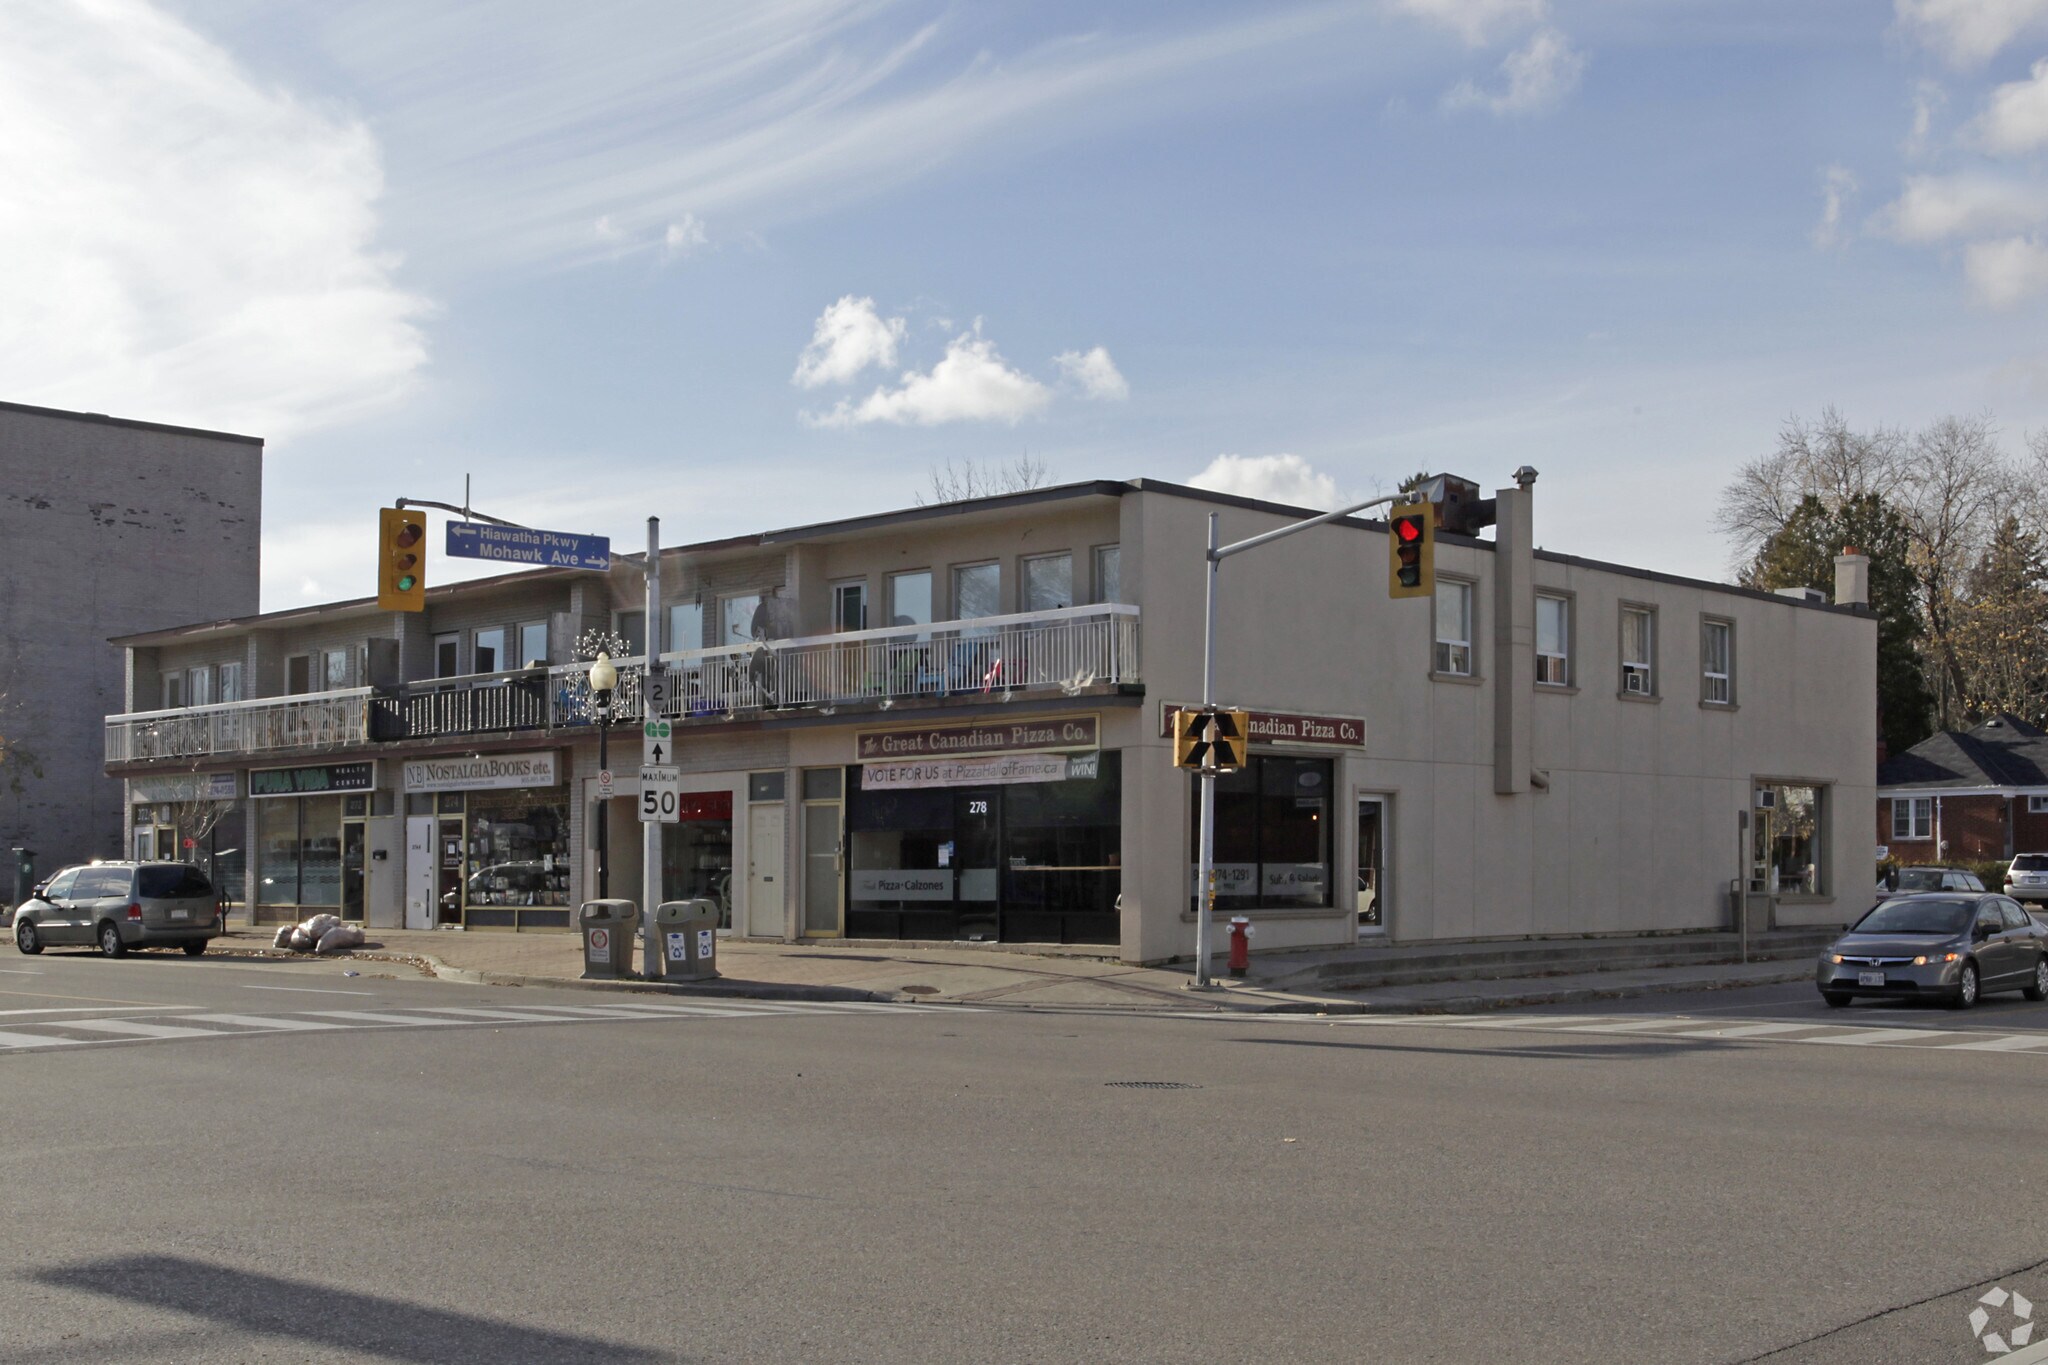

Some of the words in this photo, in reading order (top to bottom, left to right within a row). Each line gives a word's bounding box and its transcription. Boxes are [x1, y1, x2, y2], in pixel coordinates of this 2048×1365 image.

[480, 527, 540, 545] Hiawatha
[543, 533, 579, 551] Pkwy
[479, 544, 542, 563] Mohawk
[551, 551, 579, 566] Ave
[652, 684, 663, 700] 2
[645, 721, 670, 738] GO
[882, 734, 923, 752] Great
[930, 729, 1004, 749] Canadian
[1011, 727, 1055, 744] Pizza
[1063, 723, 1087, 741] Co.
[1301, 720, 1335, 738] Pizza
[1340, 722, 1358, 740] Co.
[335, 766, 366, 774] HEALTH
[533, 762, 551, 775] etc.
[868, 768, 896, 783] VOTE
[900, 767, 921, 781] FOR
[925, 767, 939, 780] US
[942, 768, 952, 779] at
[1072, 763, 1095, 776] WIN!
[642, 773, 677, 782] MAXIMUM
[644, 790, 675, 814] 50
[969, 801, 987, 814] 278
[904, 880, 943, 890] Calzones
